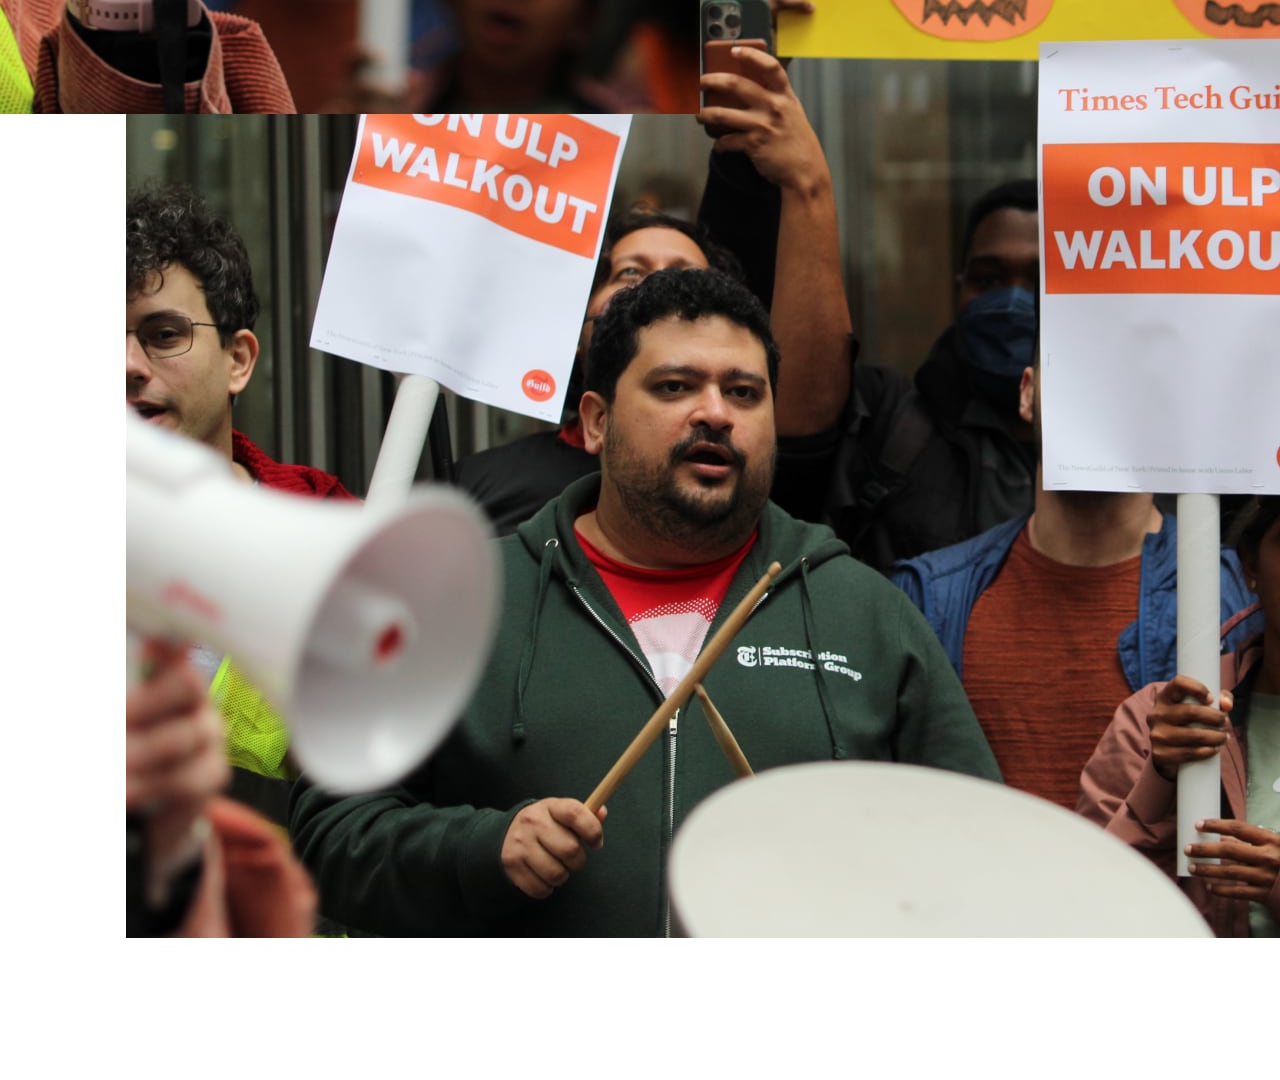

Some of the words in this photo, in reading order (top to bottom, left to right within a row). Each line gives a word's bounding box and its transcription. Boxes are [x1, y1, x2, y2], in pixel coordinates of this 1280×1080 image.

[1058, 88, 1148, 111] Times
[1154, 85, 1223, 110] Tech
[495, 114, 579, 169] ULP
[371, 133, 597, 234] WALKOUT
[1087, 166, 1167, 207] ON
[824, 662, 862, 681] Group
